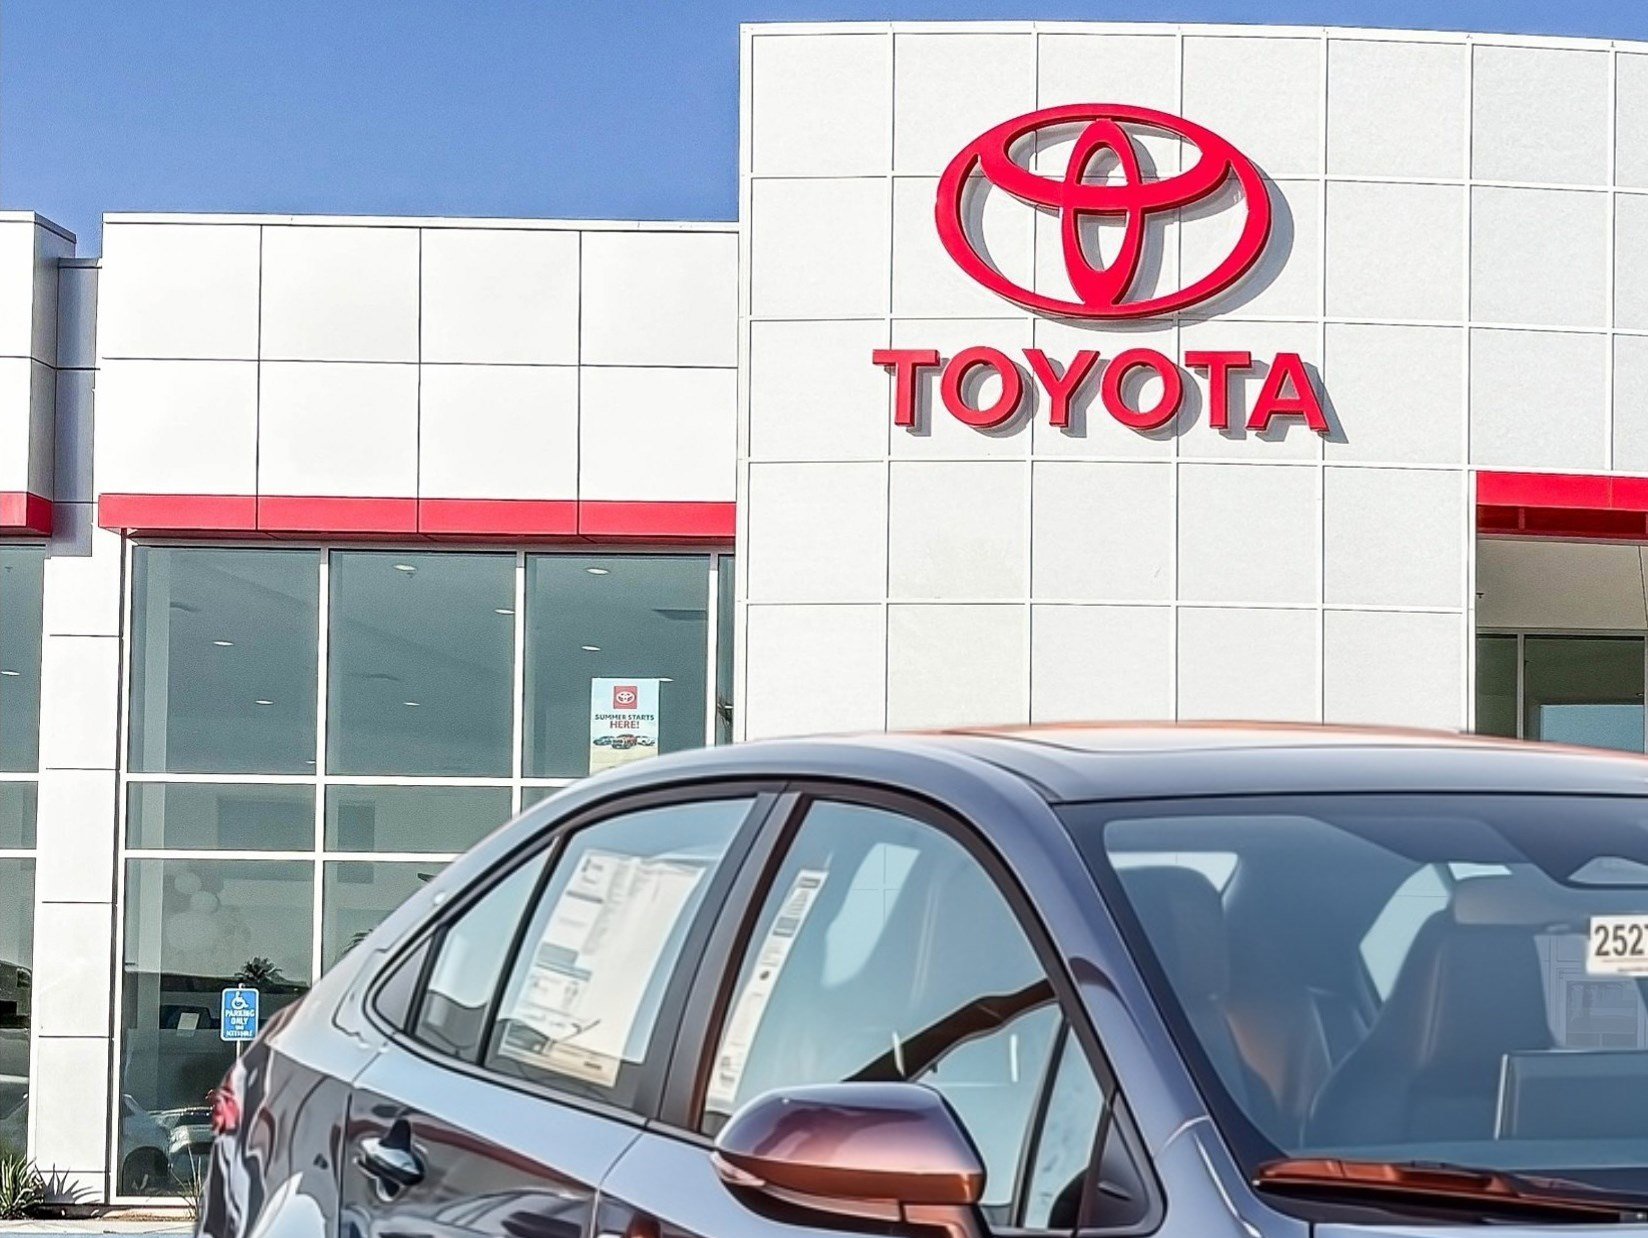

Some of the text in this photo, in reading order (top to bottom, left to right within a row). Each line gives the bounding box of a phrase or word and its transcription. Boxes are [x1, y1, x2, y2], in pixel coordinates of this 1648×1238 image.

[873, 345, 1330, 434] TOYOTA
[609, 720, 640, 729] HERE!
[225, 1009, 255, 1017] PARKING
[231, 1017, 249, 1025] ONLY
